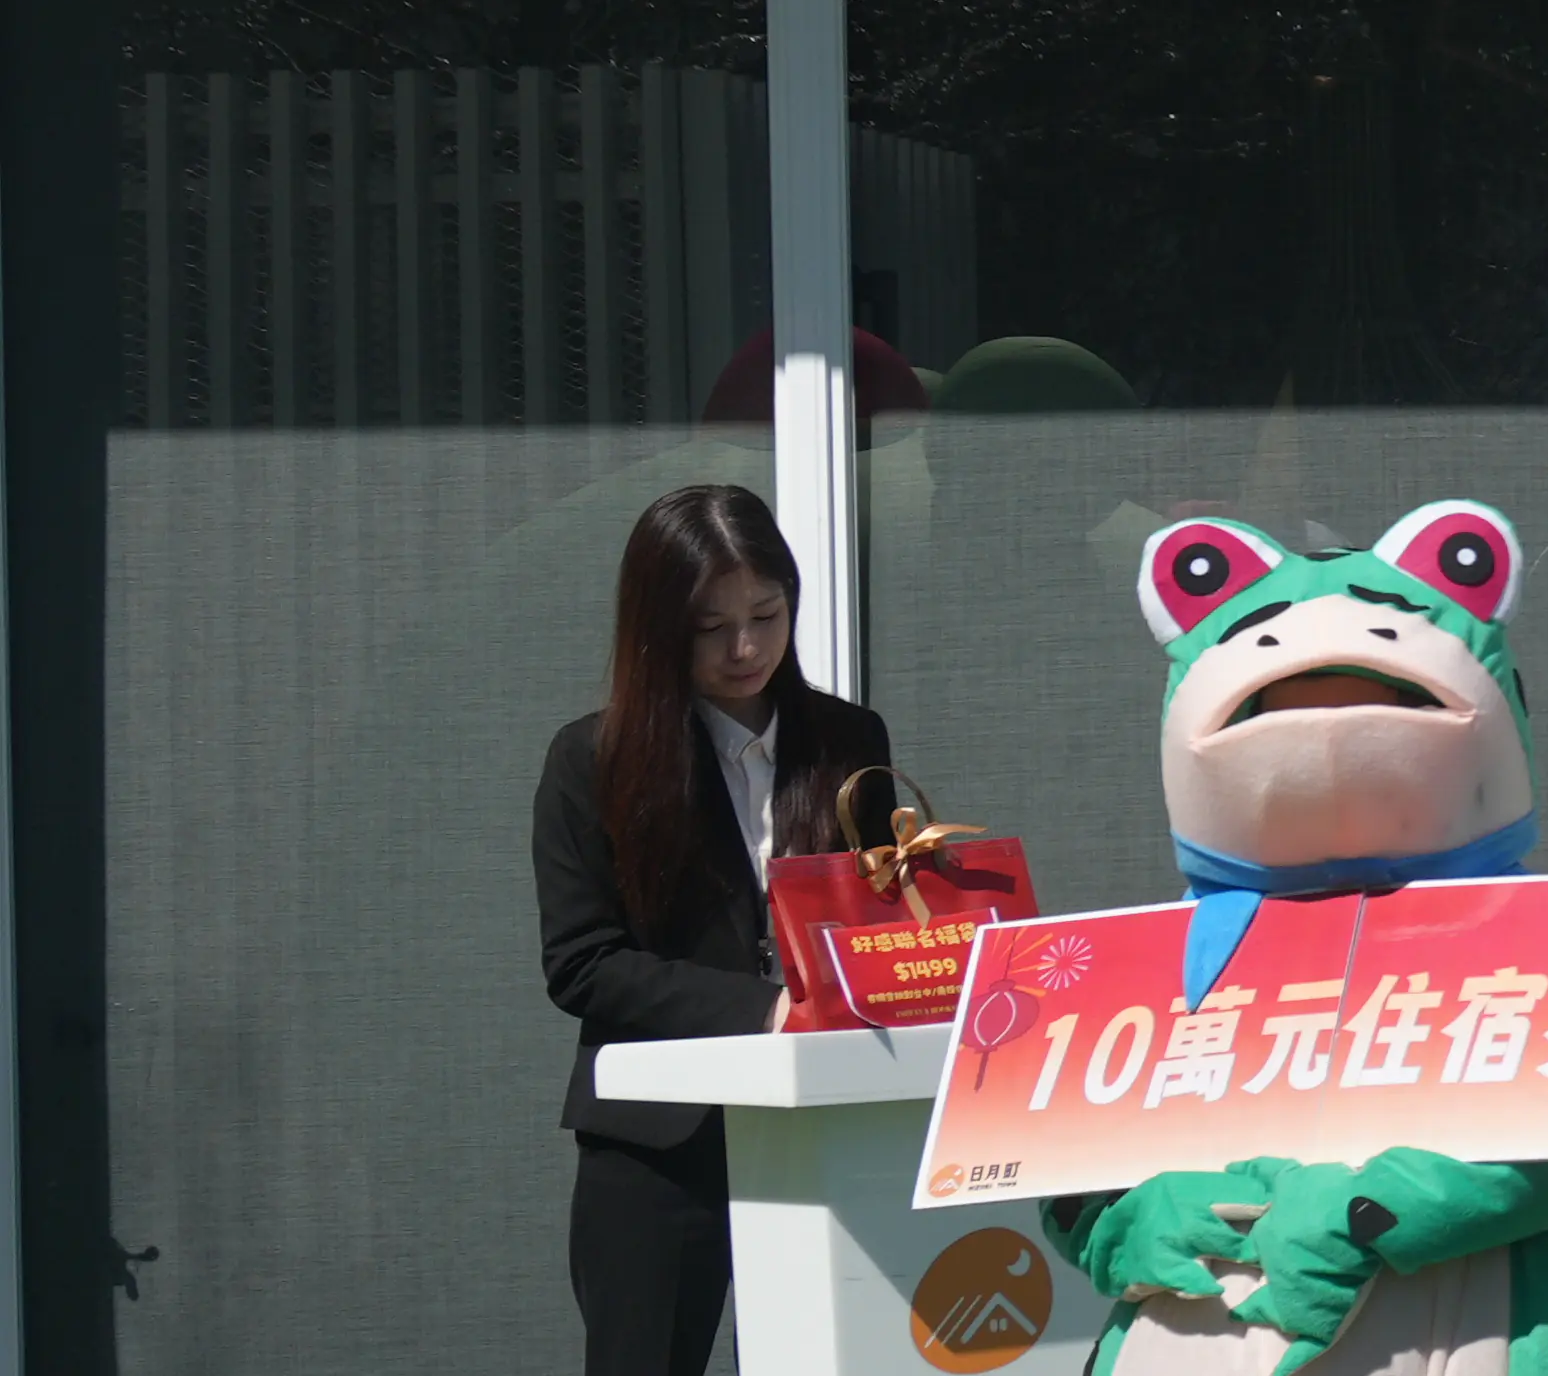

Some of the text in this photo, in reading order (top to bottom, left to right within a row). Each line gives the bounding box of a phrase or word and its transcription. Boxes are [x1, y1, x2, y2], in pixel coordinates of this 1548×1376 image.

[893, 957, 958, 982] $1499
[970, 1161, 1022, 1182] 日月町
